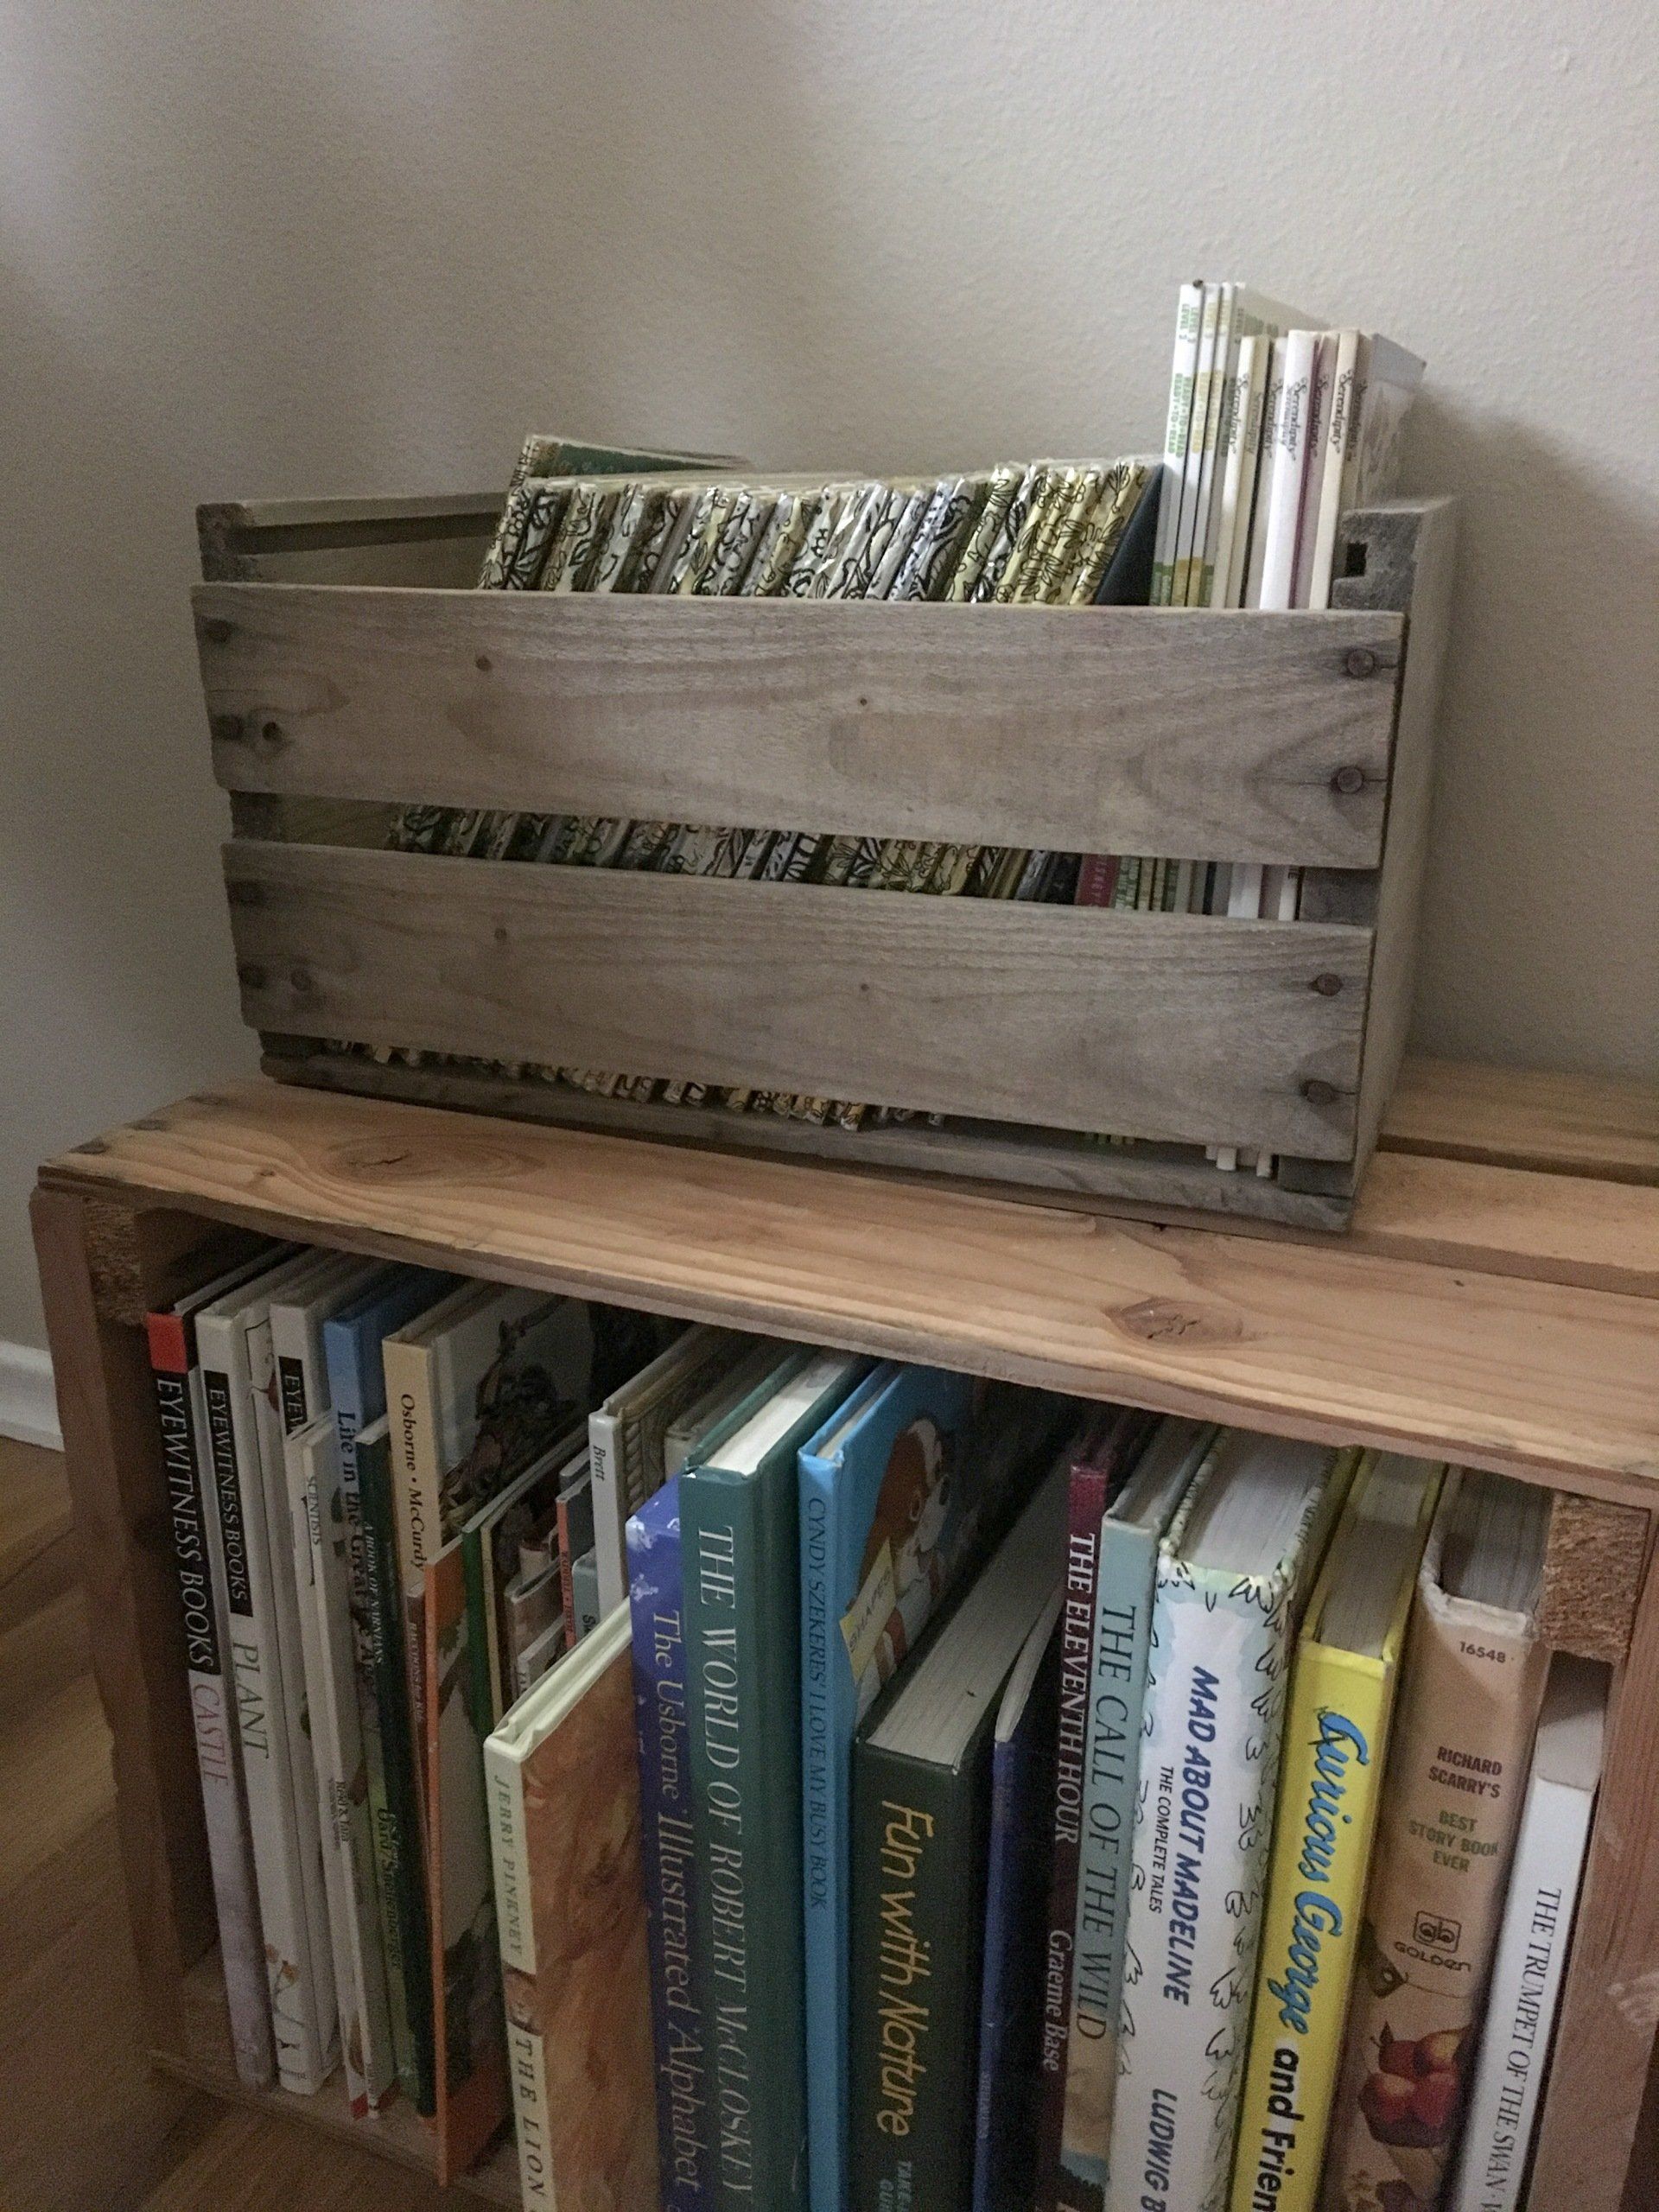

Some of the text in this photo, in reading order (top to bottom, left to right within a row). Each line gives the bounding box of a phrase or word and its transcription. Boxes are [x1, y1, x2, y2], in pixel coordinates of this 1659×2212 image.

[1179, 303, 1191, 329] LEVEL
[1287, 377, 1307, 461] Serendipity
[1330, 369, 1353, 454] Serendipity
[209, 1388, 247, 1600] EYEWITNESS BOOKS
[343, 1462, 358, 1482] in
[401, 1394, 427, 1573] Osborne McCurdy
[593, 1445, 607, 1482] Brett
[156, 1378, 215, 1668] EYEWITNESS BOOKS
[808, 1497, 826, 1575] CYNDY
[653, 1609, 683, 1669] The
[808, 1580, 827, 1688] SZEKERES'
[1459, 1640, 1508, 1664] 16548
[193, 1684, 230, 1786] CASTLE
[232, 1642, 270, 1759] PLANT
[810, 1705, 827, 1759] LOVE
[1055, 1533, 1096, 1845] THE ELEVENTH HOUR
[657, 1679, 686, 1802] Usborne
[810, 1764, 827, 1798] MY
[1428, 1765, 1501, 1799] SCARRY'S
[1436, 1745, 1503, 1776] RICHARD
[810, 1799, 827, 1849] BUSY
[1076, 1605, 1137, 2040] THE CALL OF THE WILD
[1148, 1765, 1174, 1915] THE COMPLETE TALES
[1163, 1664, 1220, 2006] MAD ABOUT MADELINE
[1299, 1711, 1370, 1883] Curious
[1408, 1820, 1499, 1857] STORY BOOK
[1438, 1810, 1478, 1834] BEST
[494, 1774, 523, 1955] JERRY PINKNEY
[698, 1525, 753, 2206] THE WORLD OF ROBERT McCLOSKEY
[810, 1854, 828, 1910] BOOK
[1433, 1849, 1471, 1873] EVER
[658, 1811, 702, 2015] Illustrated
[1531, 1888, 1562, 1938] THE
[876, 1800, 935, 2136] Fun with Nature
[1043, 1929, 1074, 2073] Graeme Base
[1267, 1891, 1344, 2035] George
[1511, 1942, 1552, 2050] TRUMPET
[660, 2020, 709, 2193] Alphabet
[1267, 2047, 1306, 2122] and
[1496, 2085, 1526, 2132] THE
[1506, 2050, 1531, 2083] OF
[516, 2038, 546, 2197] THE LION
[1144, 2088, 1178, 2192] LUDWIG
[1484, 2131, 1516, 2192] SWAN
